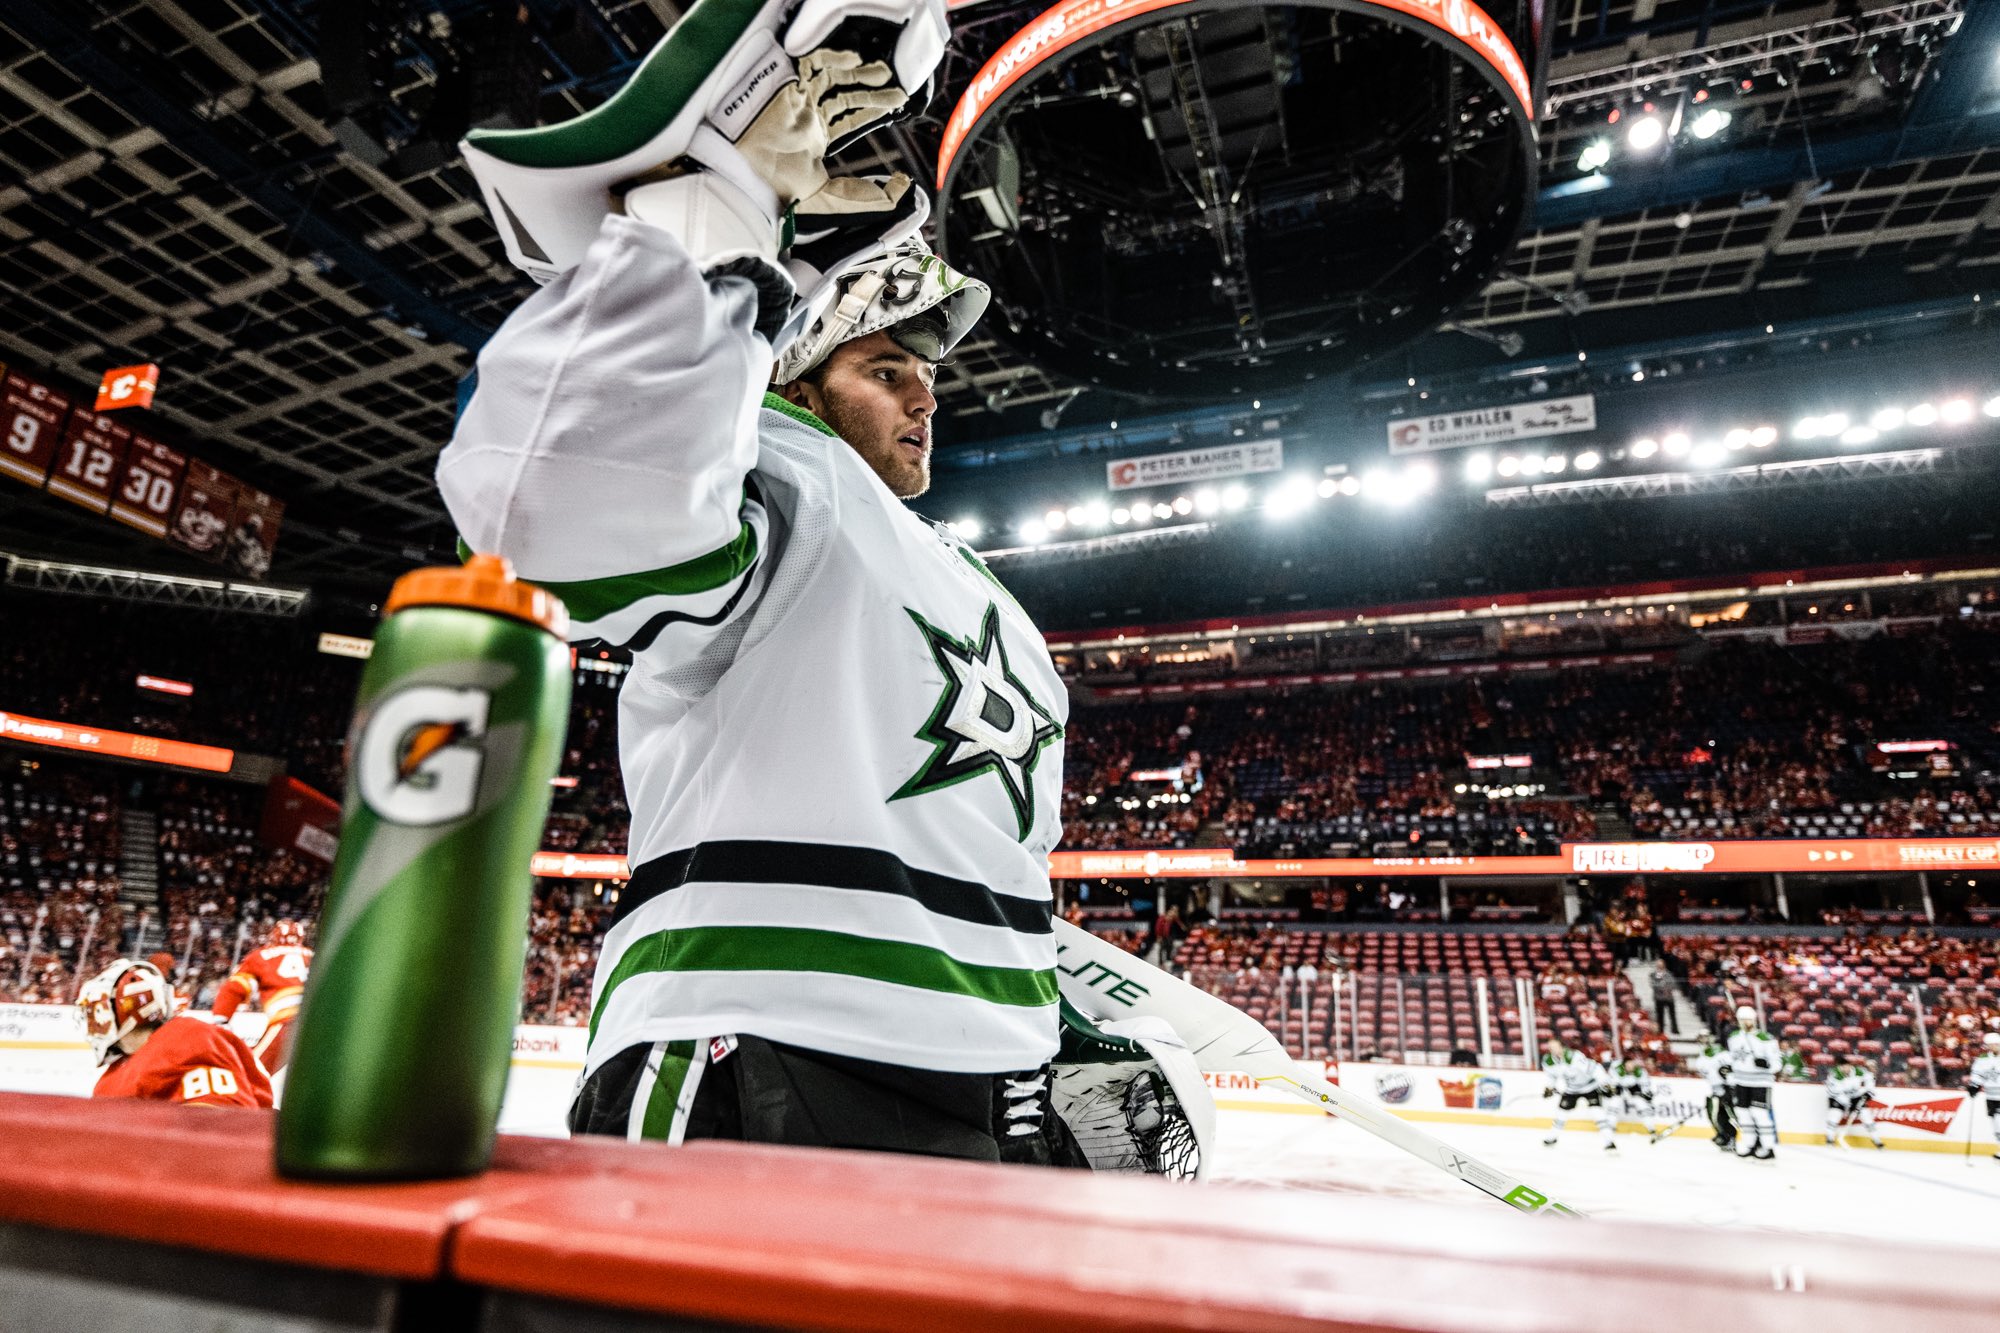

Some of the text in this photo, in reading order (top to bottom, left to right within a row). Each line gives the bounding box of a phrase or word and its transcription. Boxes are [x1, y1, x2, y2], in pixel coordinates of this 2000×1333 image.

[724, 61, 778, 117] OETTINGER
[8, 413, 40, 454] 9
[1429, 420, 1448, 432] ED
[1453, 409, 1513, 429] WHALEN
[65, 439, 113, 488] 12
[1140, 457, 1186, 472] PETER
[1189, 449, 1242, 466] MAHER
[123, 465, 174, 514] 30
[358, 686, 489, 825] G
[1898, 845, 1998, 863] STANLEY CUP
[182, 1067, 238, 1100] 80
